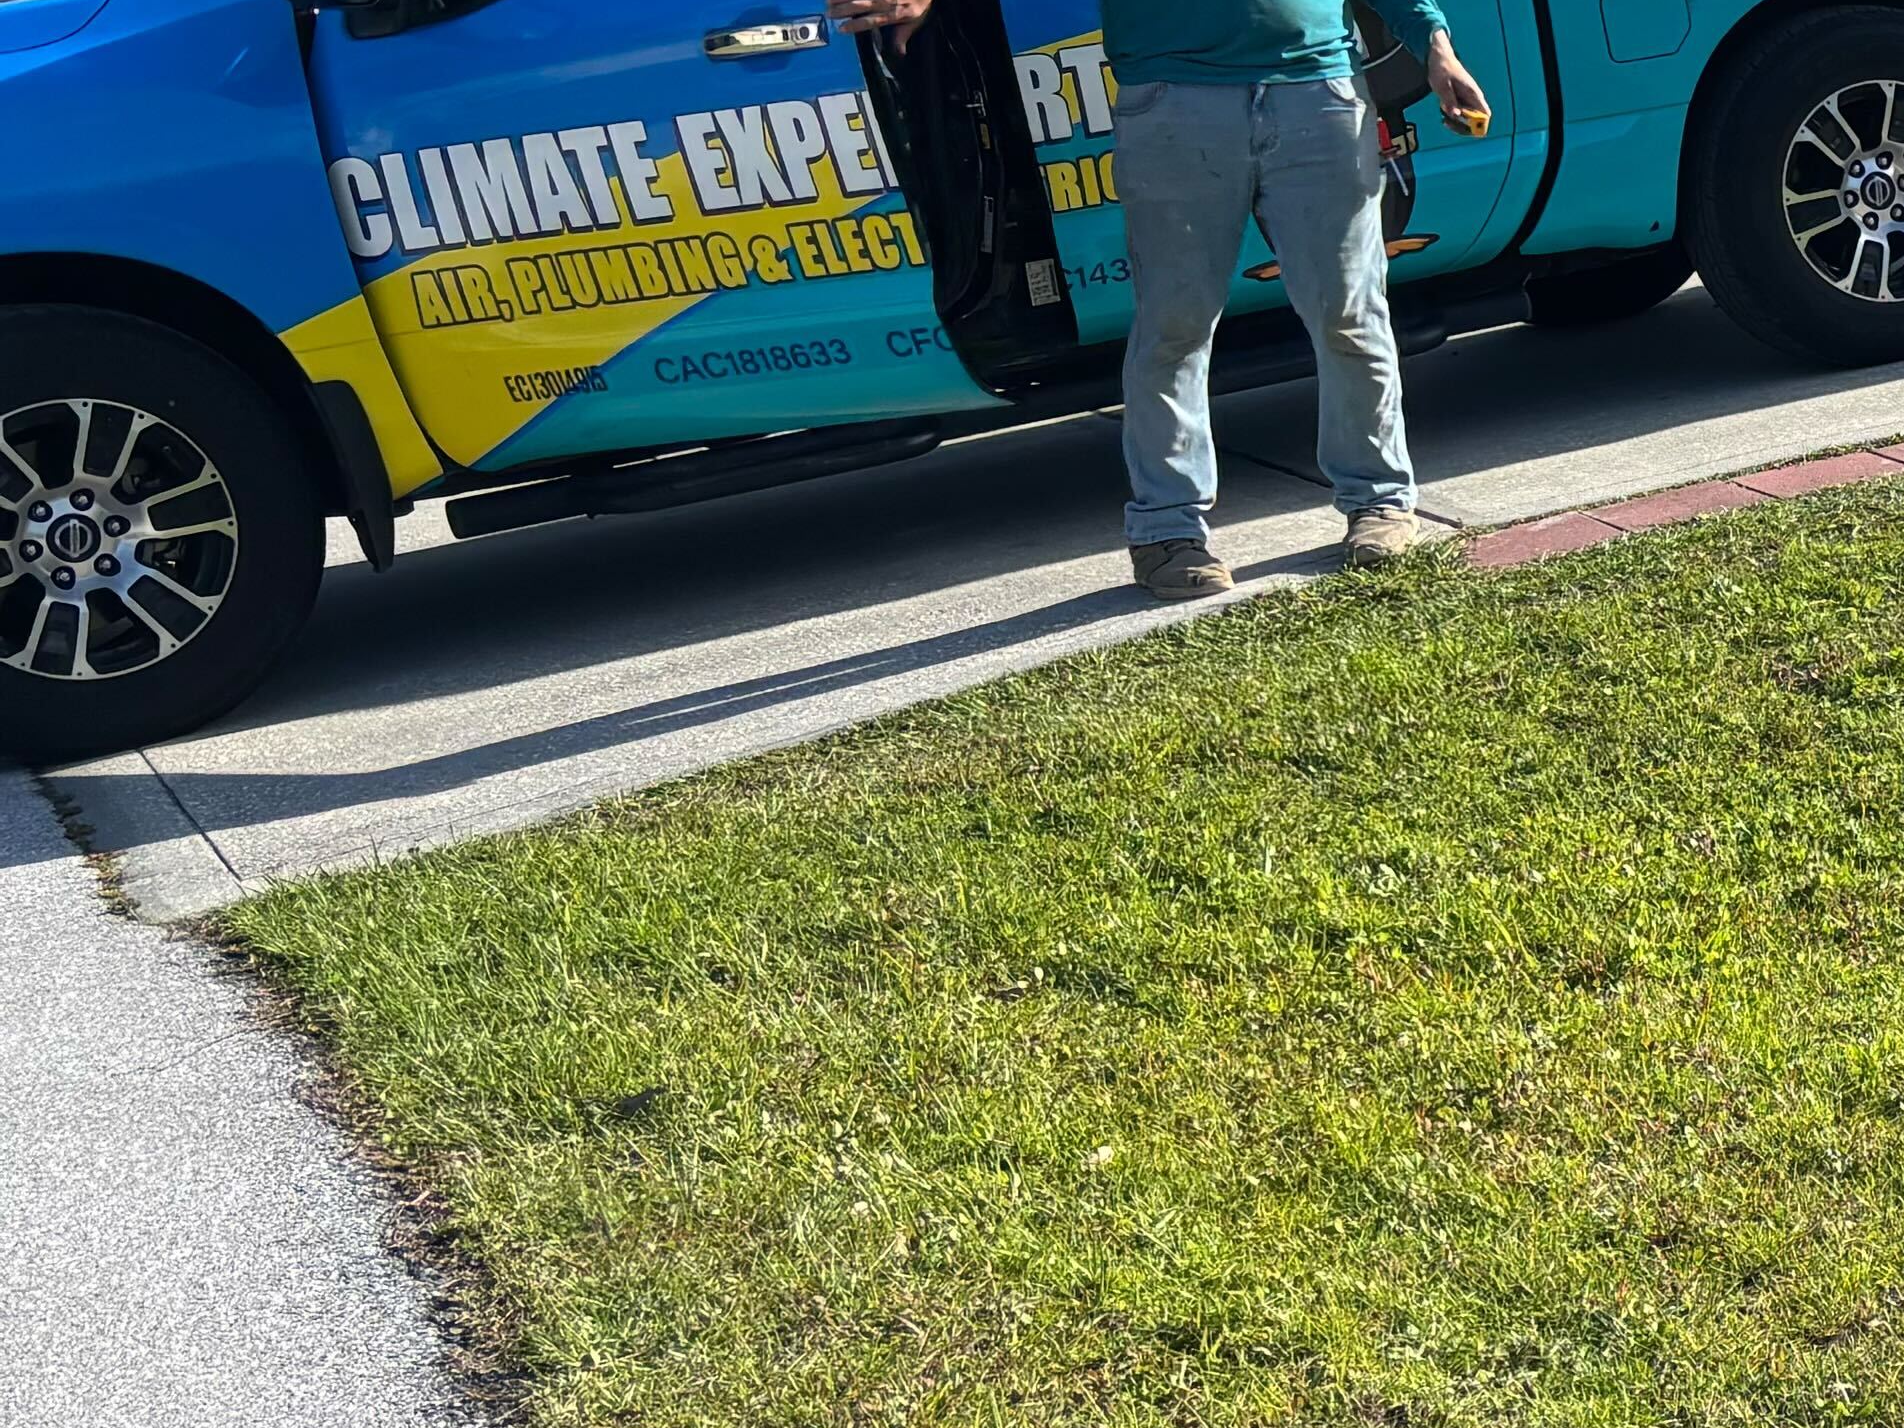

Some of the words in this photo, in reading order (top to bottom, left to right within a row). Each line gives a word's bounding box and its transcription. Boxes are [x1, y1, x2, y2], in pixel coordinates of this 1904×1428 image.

[327, 120, 675, 259] CLIMATE
[412, 262, 525, 329] AIR,
[507, 231, 749, 315] PLUMBING
[749, 234, 797, 284] &
[654, 338, 852, 384] CAC1818633
